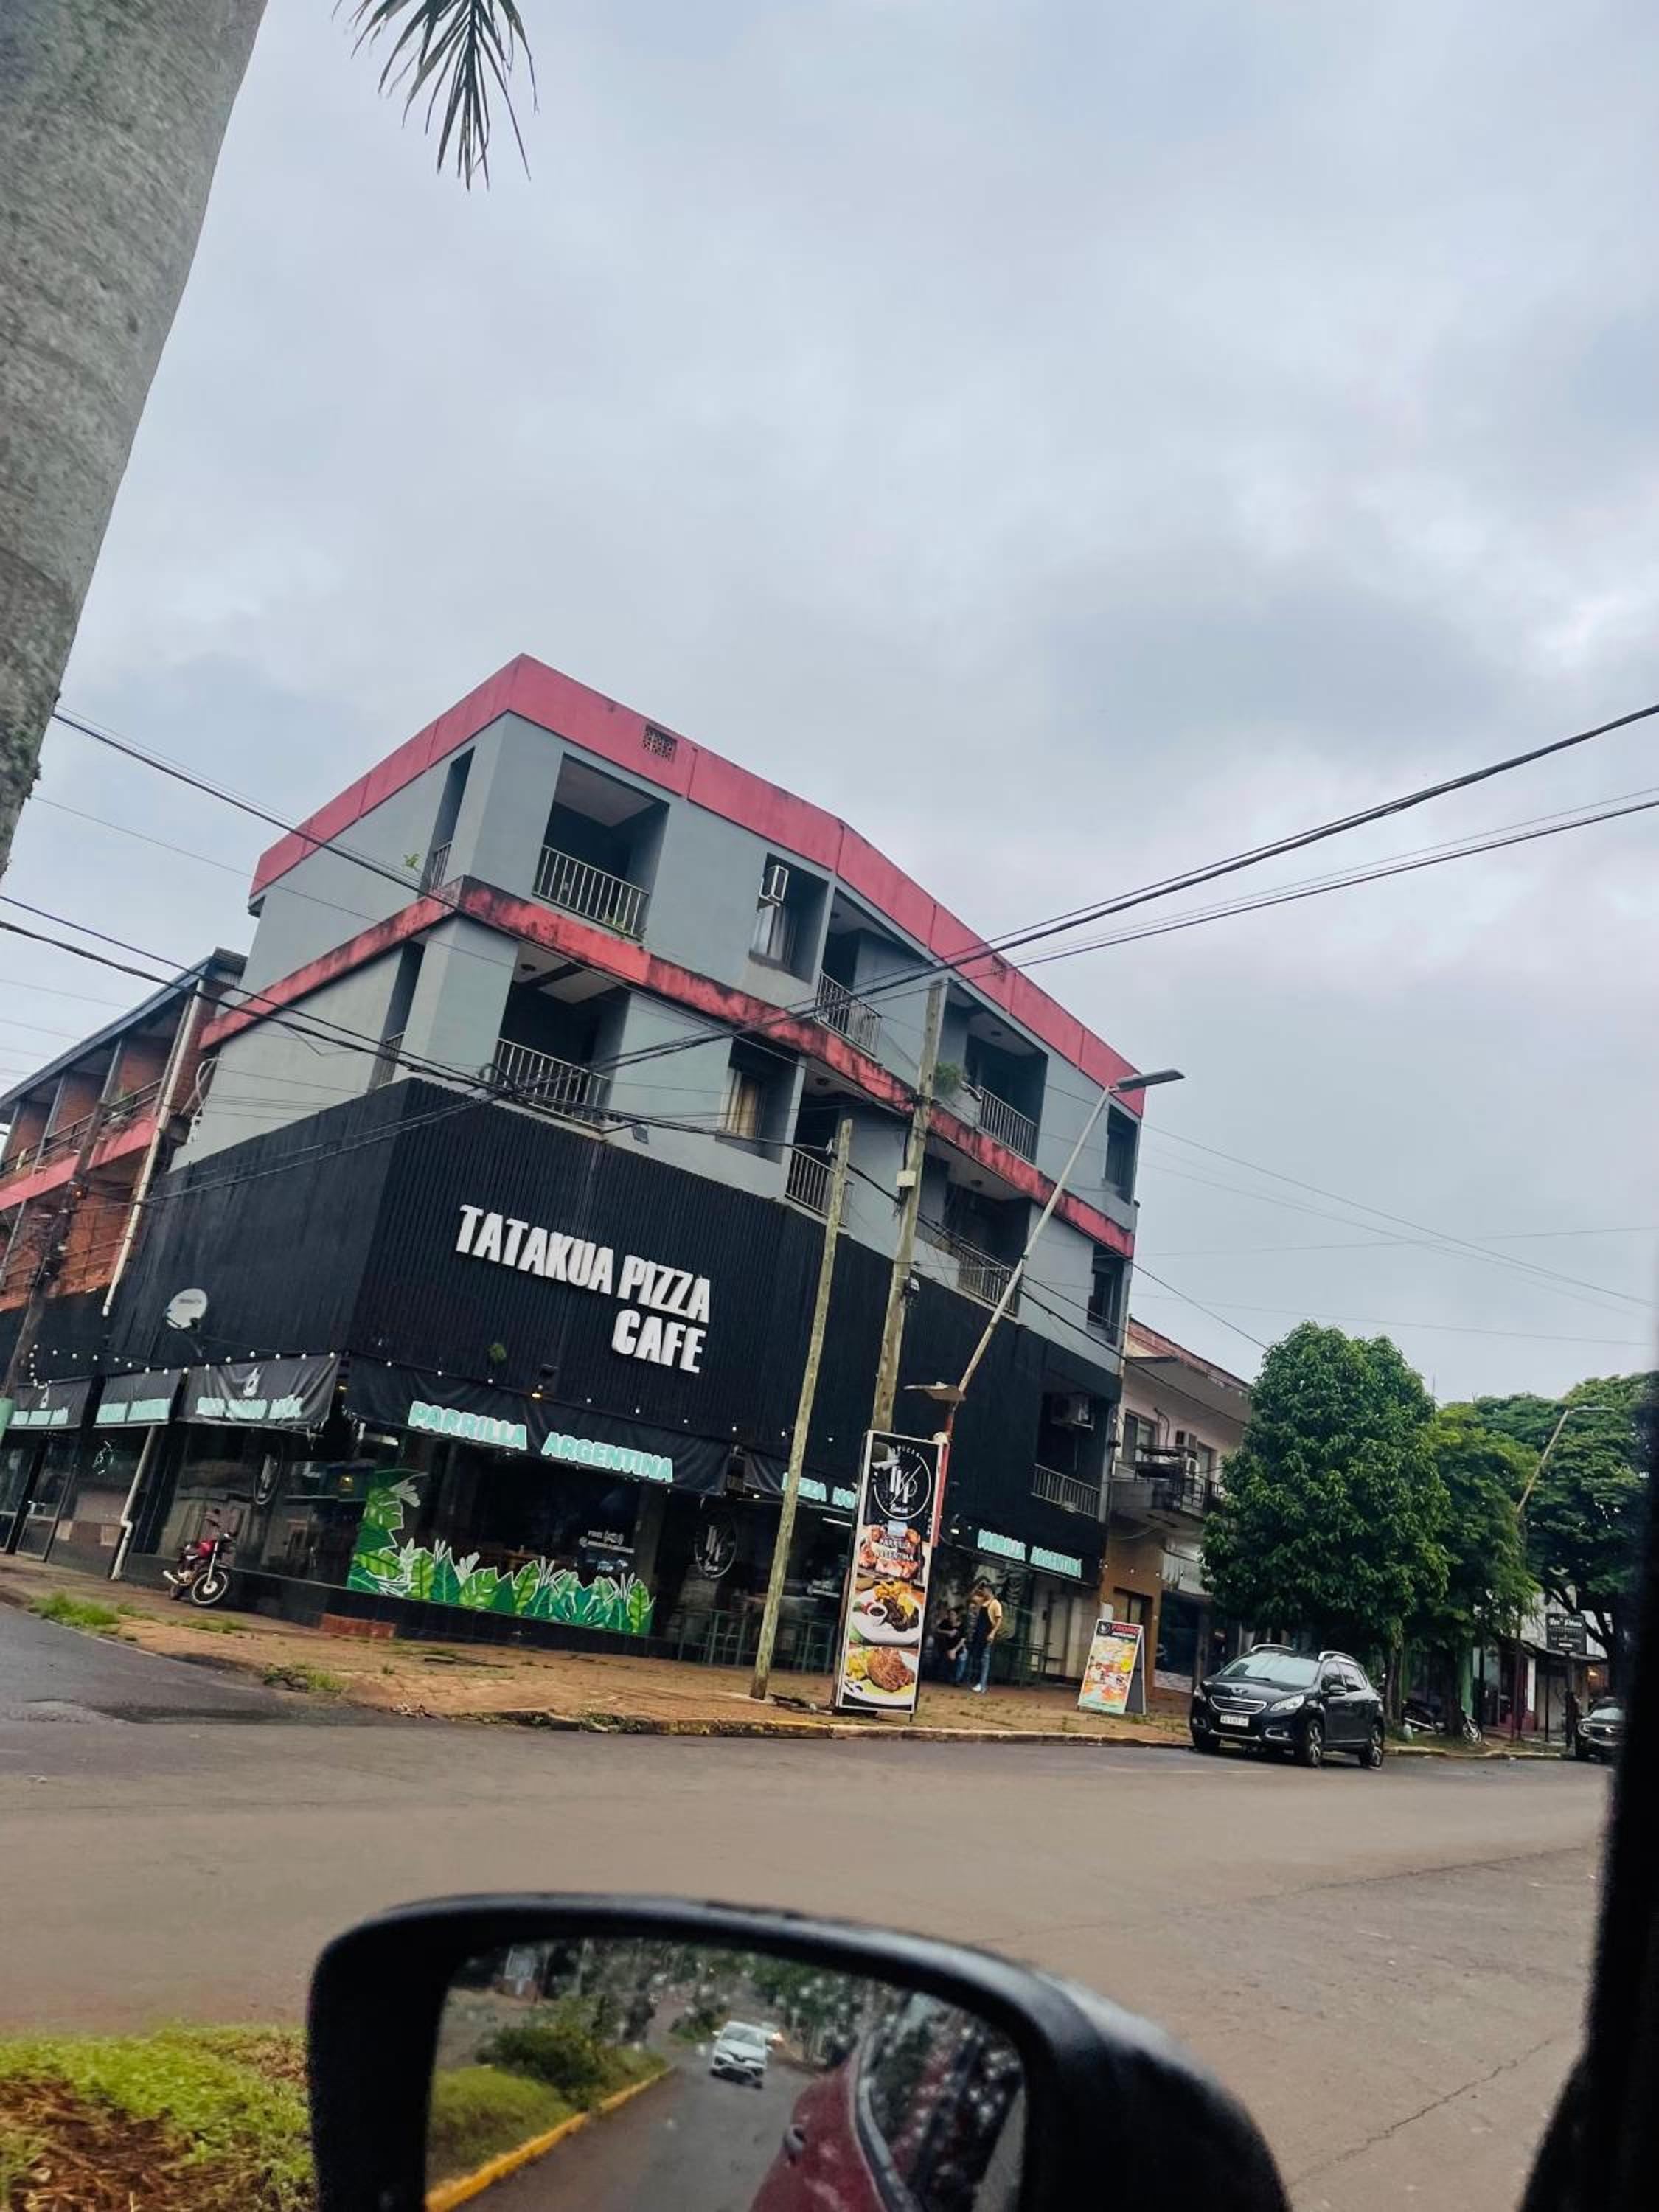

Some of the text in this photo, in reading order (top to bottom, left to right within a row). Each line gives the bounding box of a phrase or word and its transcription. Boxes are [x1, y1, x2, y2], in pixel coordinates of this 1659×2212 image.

[455, 1204, 711, 1324] TATAKUA PIZZA
[611, 1309, 707, 1374] CAFE
[408, 1400, 673, 1483] PARRILLA ARGENTINA
[781, 1472, 827, 1502] ZZA
